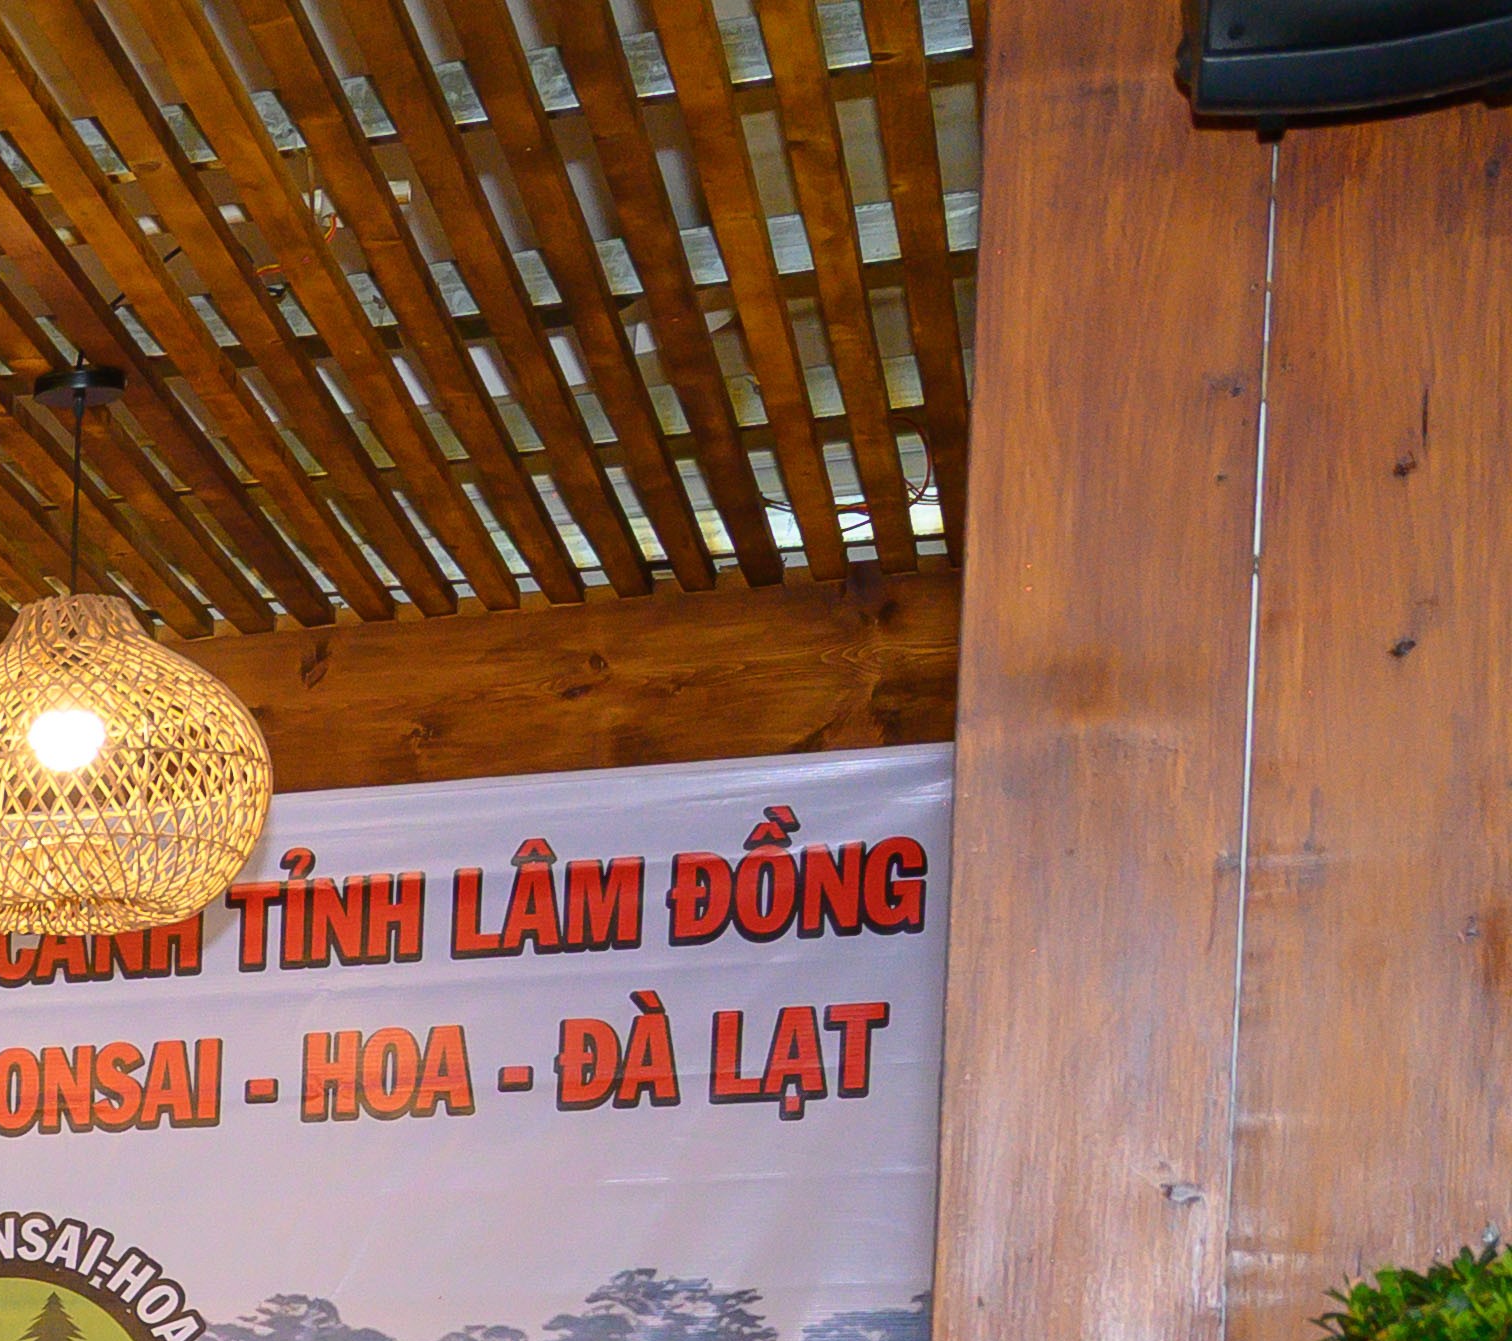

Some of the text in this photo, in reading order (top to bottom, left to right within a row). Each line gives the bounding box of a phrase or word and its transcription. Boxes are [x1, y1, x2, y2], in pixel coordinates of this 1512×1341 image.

[226, 846, 426, 974] TỈNH
[451, 836, 649, 962] LÂM
[666, 805, 928, 946] ĐỒNG
[243, 1076, 279, 1105] -
[299, 1022, 475, 1125] HOA
[497, 1064, 535, 1093] -
[553, 989, 682, 1113] ĐÀ
[708, 1001, 891, 1121] LẠT
